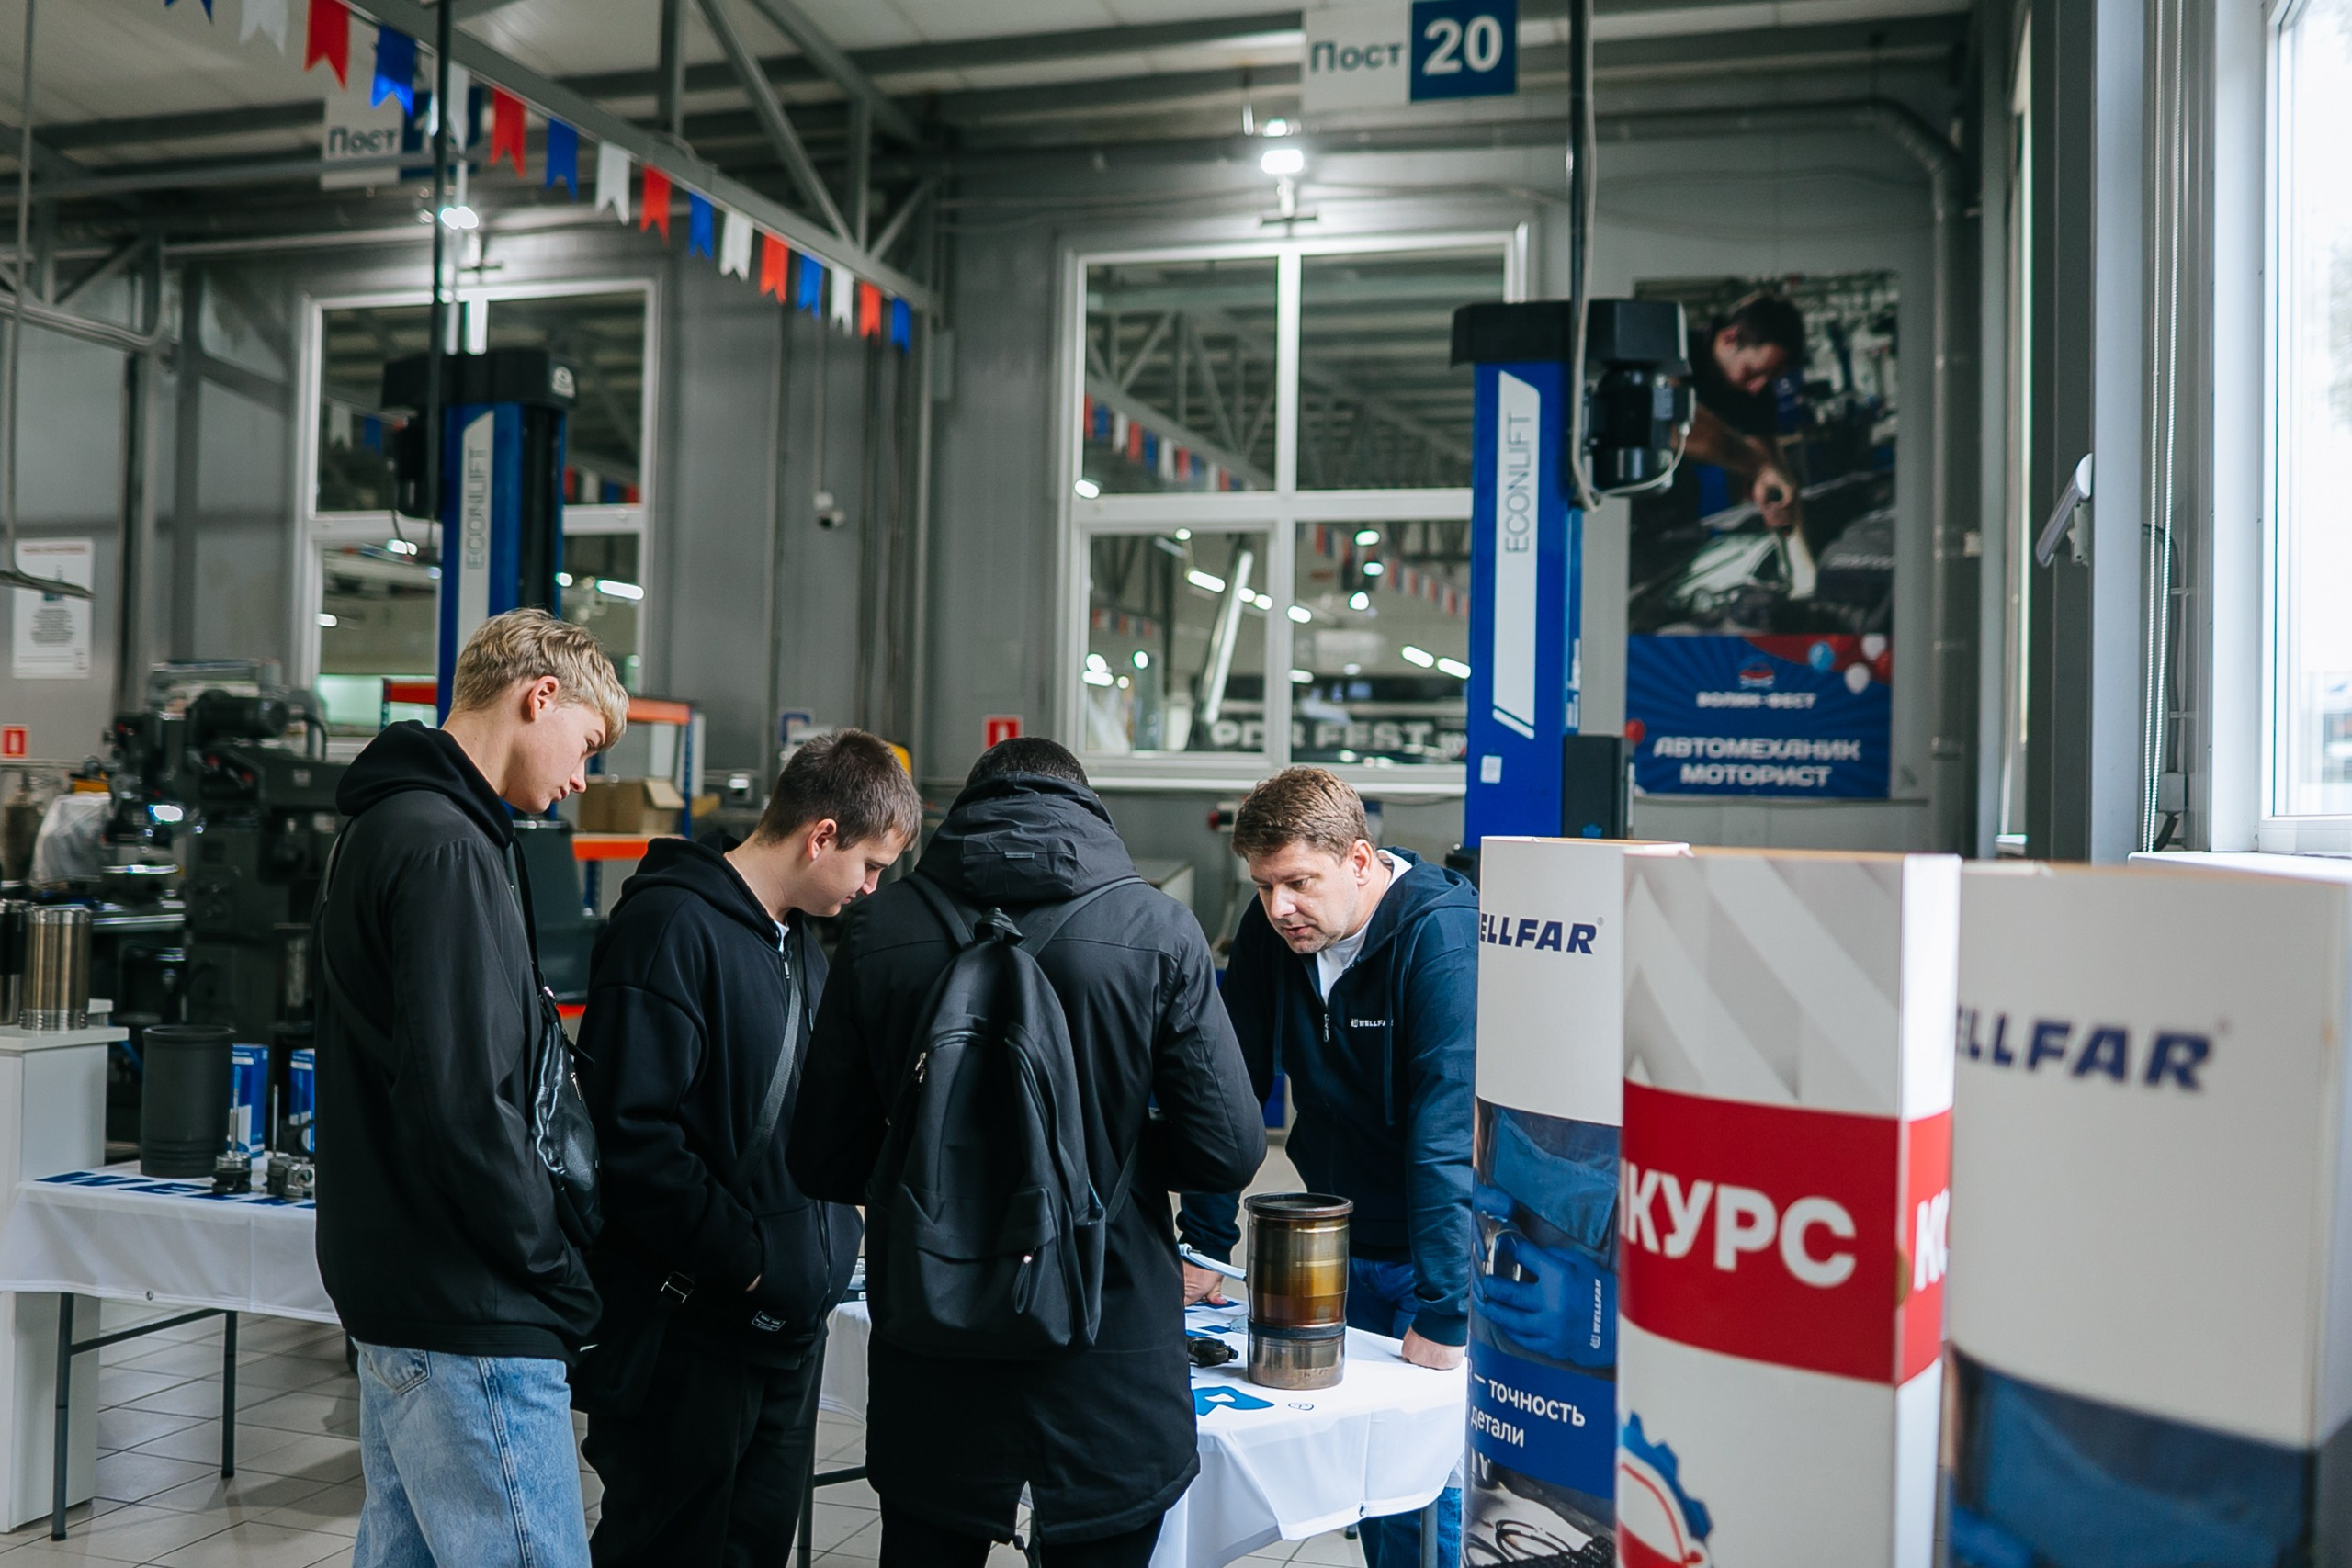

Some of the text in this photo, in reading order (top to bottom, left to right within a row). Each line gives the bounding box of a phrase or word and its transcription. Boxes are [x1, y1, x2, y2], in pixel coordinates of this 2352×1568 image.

[1310, 14, 1503, 75] Пост 20
[328, 127, 398, 154] Пост
[1505, 413, 1532, 554] ECONLIFT
[466, 449, 488, 570] ECONLIFT
[1313, 720, 1434, 754] FEST
[1653, 736, 1861, 761] АВТОМЕХАНИК
[1679, 763, 1832, 787] МОТОРИСТ
[1488, 1378, 1586, 1427] точность
[1470, 1405, 1525, 1448] детали
